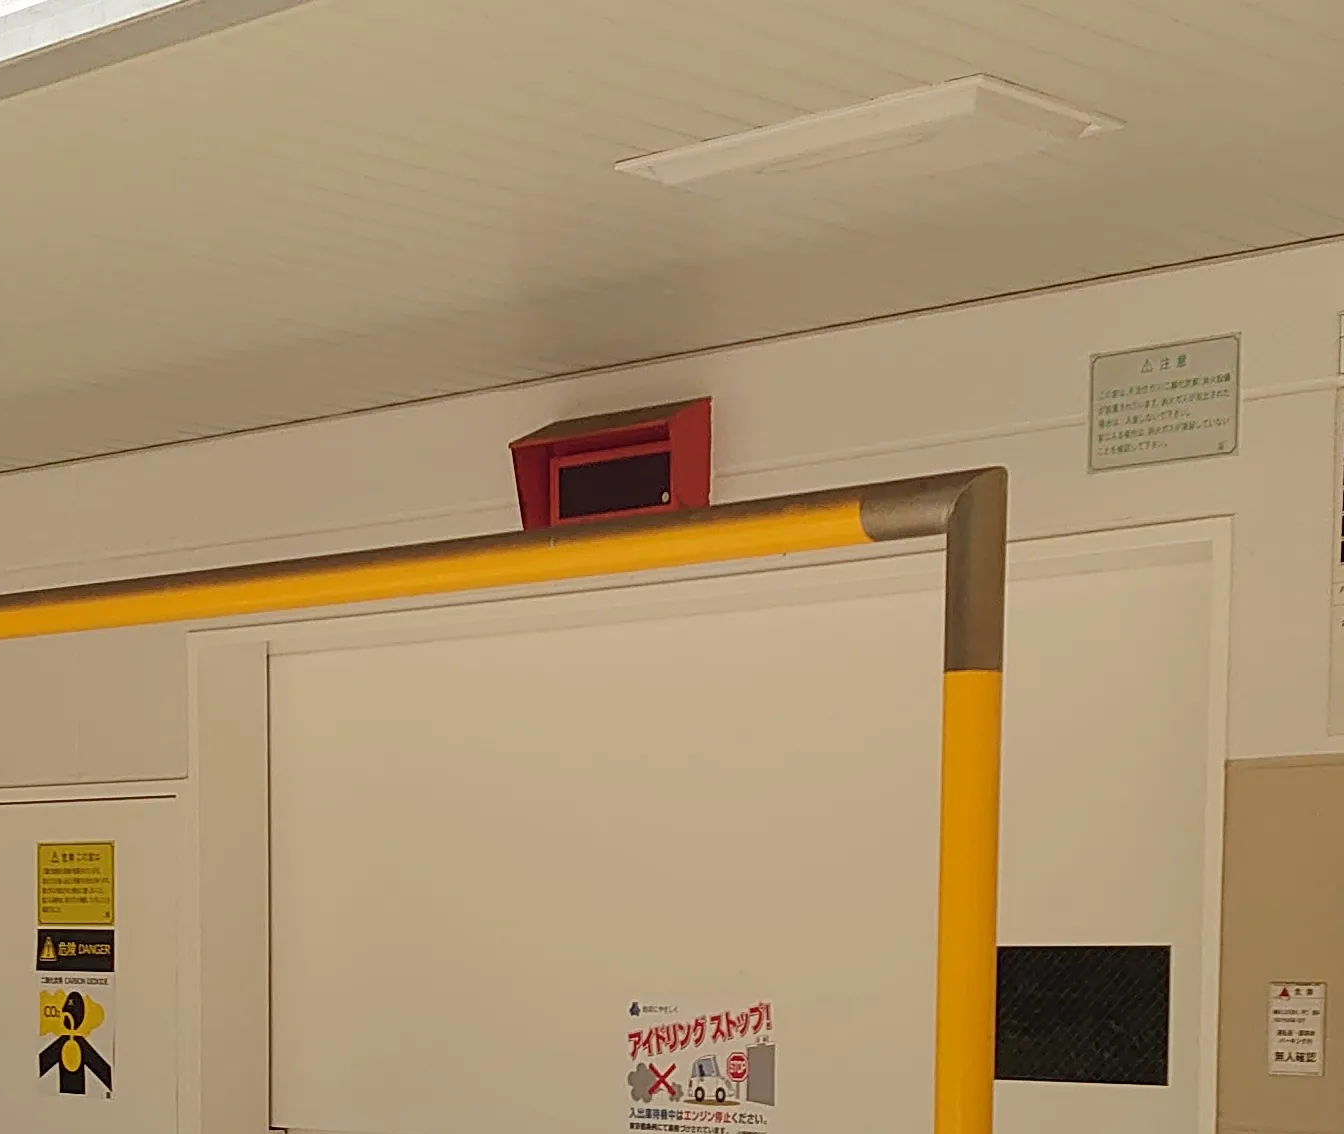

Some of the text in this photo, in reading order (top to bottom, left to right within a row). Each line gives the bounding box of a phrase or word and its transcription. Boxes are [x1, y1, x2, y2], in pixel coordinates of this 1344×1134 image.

[58, 941, 111, 956] 危険 DANGER
[628, 1001, 773, 1062] アイドリング ストップ!
[1275, 1051, 1317, 1063] 無人確認
